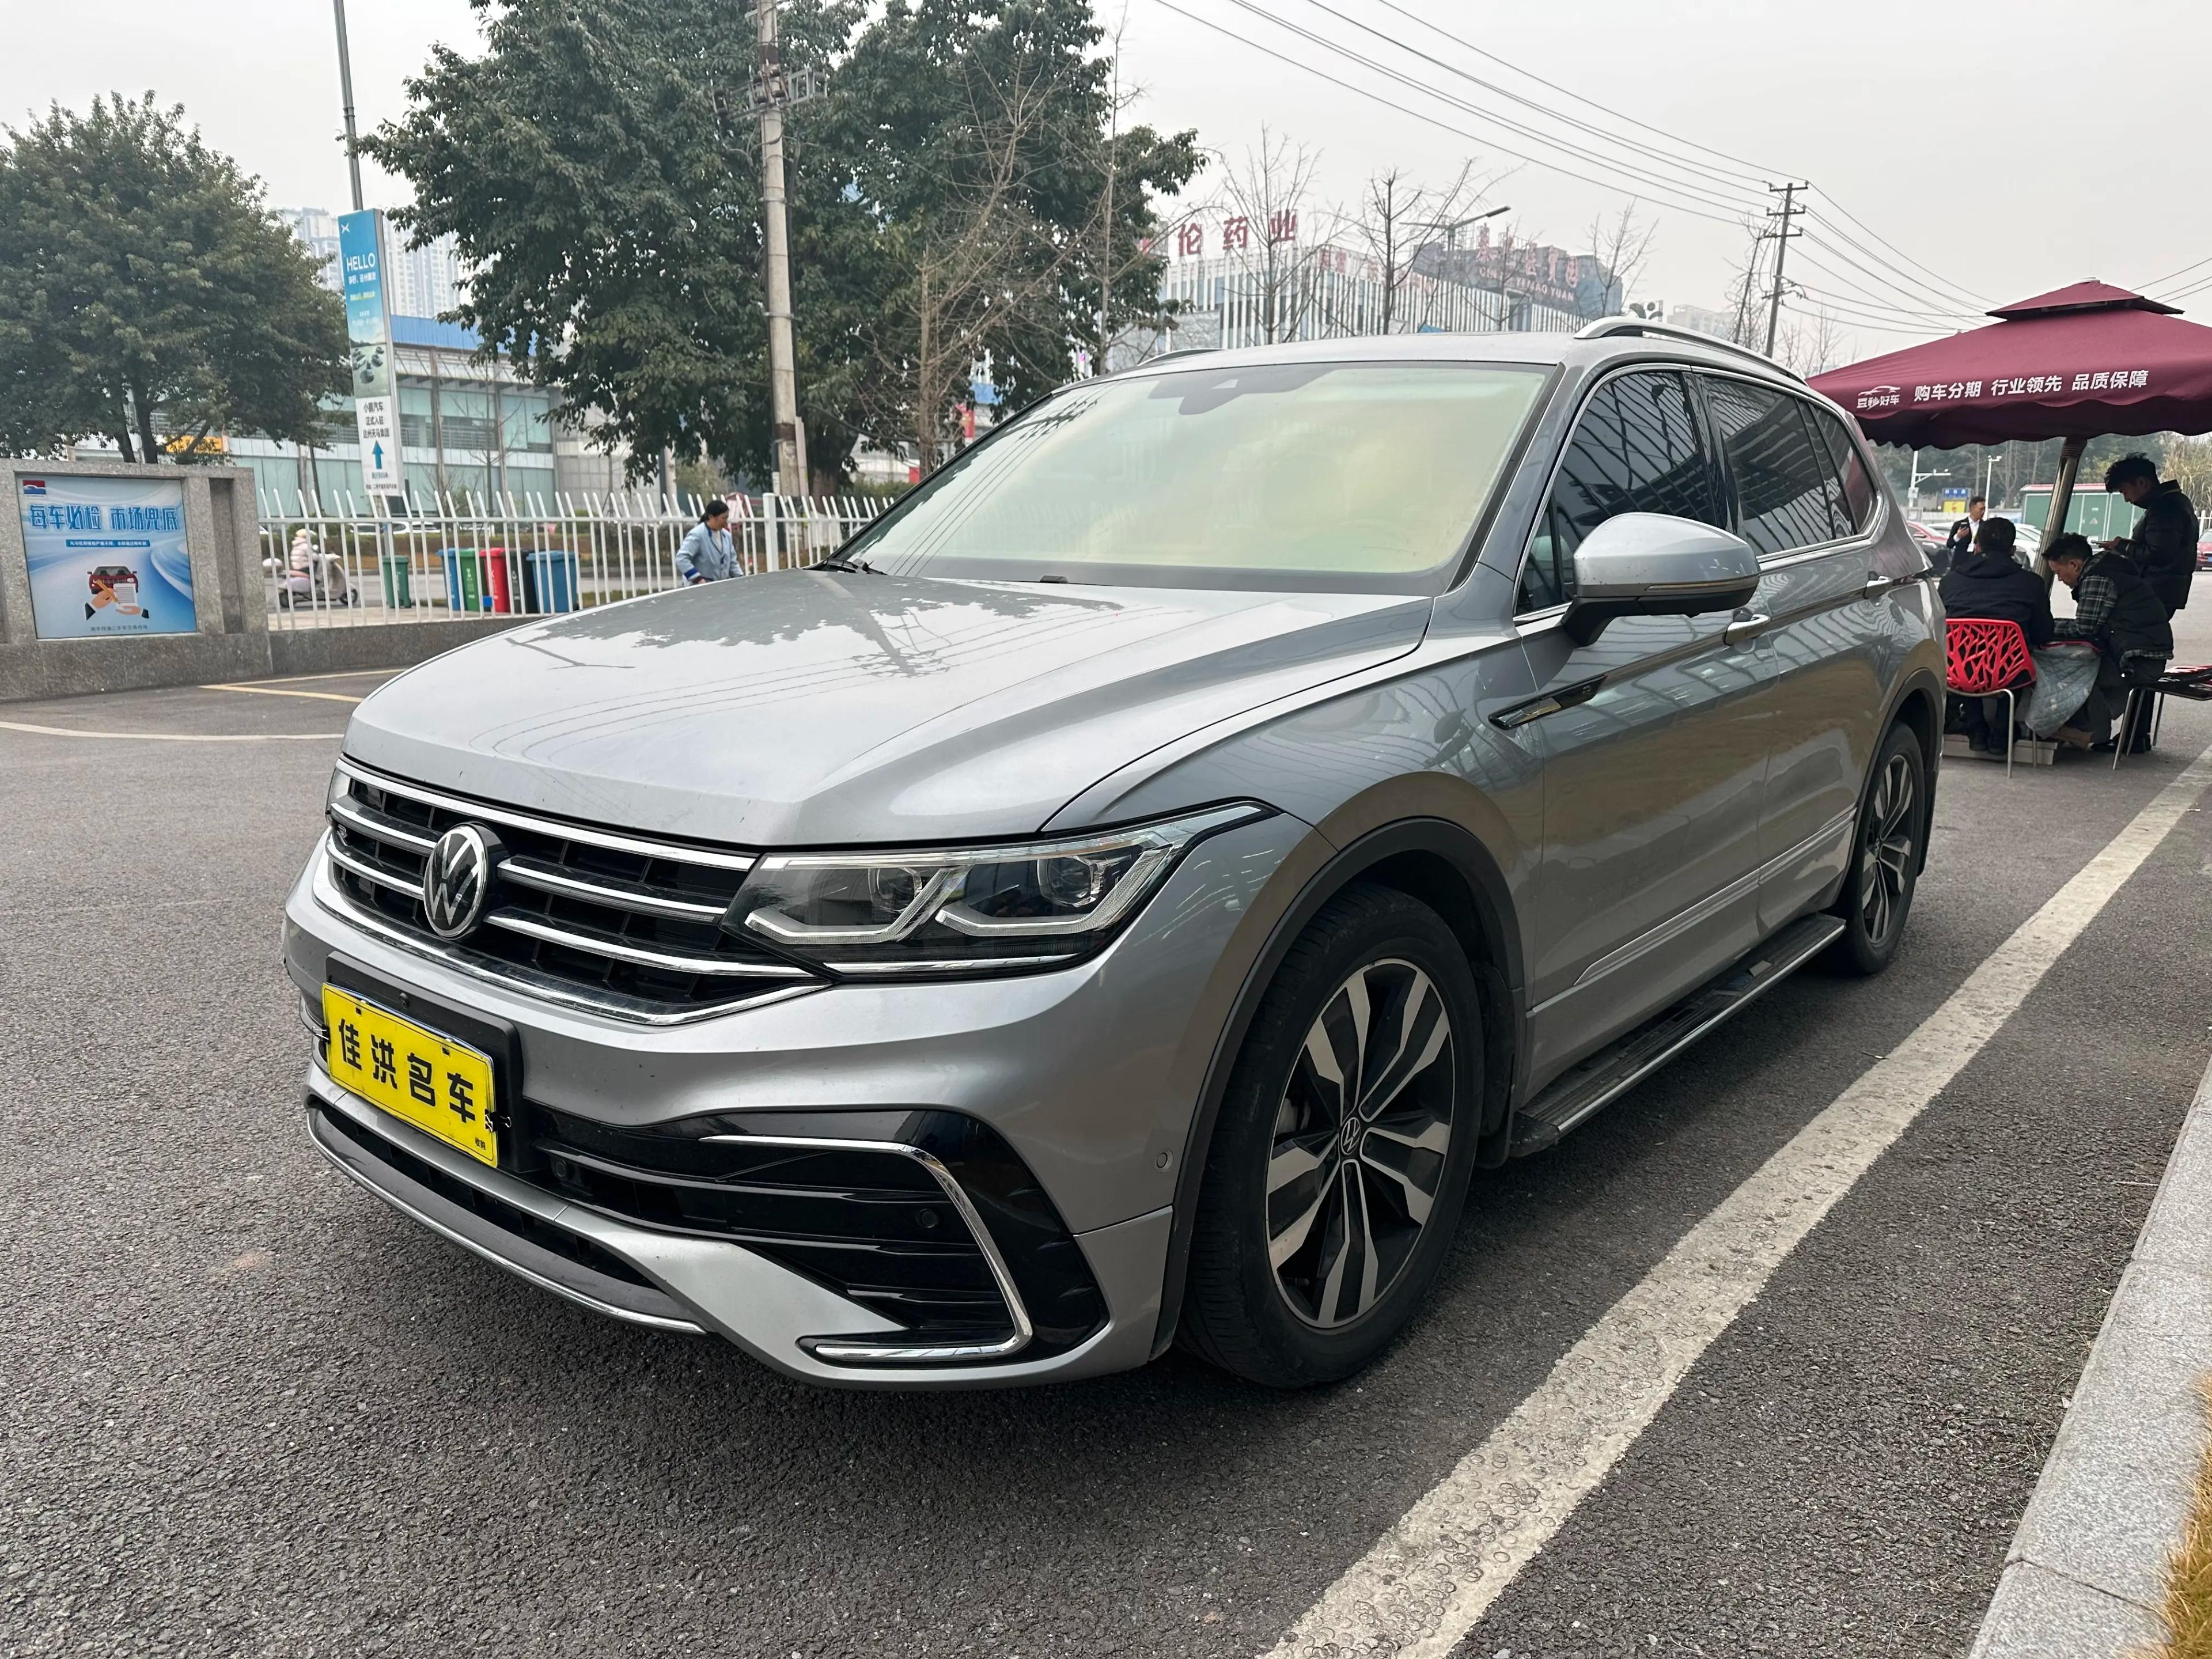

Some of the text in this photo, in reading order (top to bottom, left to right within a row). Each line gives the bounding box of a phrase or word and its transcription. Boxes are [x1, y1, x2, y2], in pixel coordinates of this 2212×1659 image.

[1135, 209, 1296, 257] 伦药业
[346, 252, 375, 272] HELLO
[1551, 286, 1574, 302] YUAN
[1914, 381, 1981, 402] 购车分期
[1991, 375, 2062, 396] 行业领先
[2072, 369, 2149, 391] 品质保障
[29, 505, 179, 531] 每车必检 市场兜底
[338, 1018, 476, 1123] 佳洪名车
